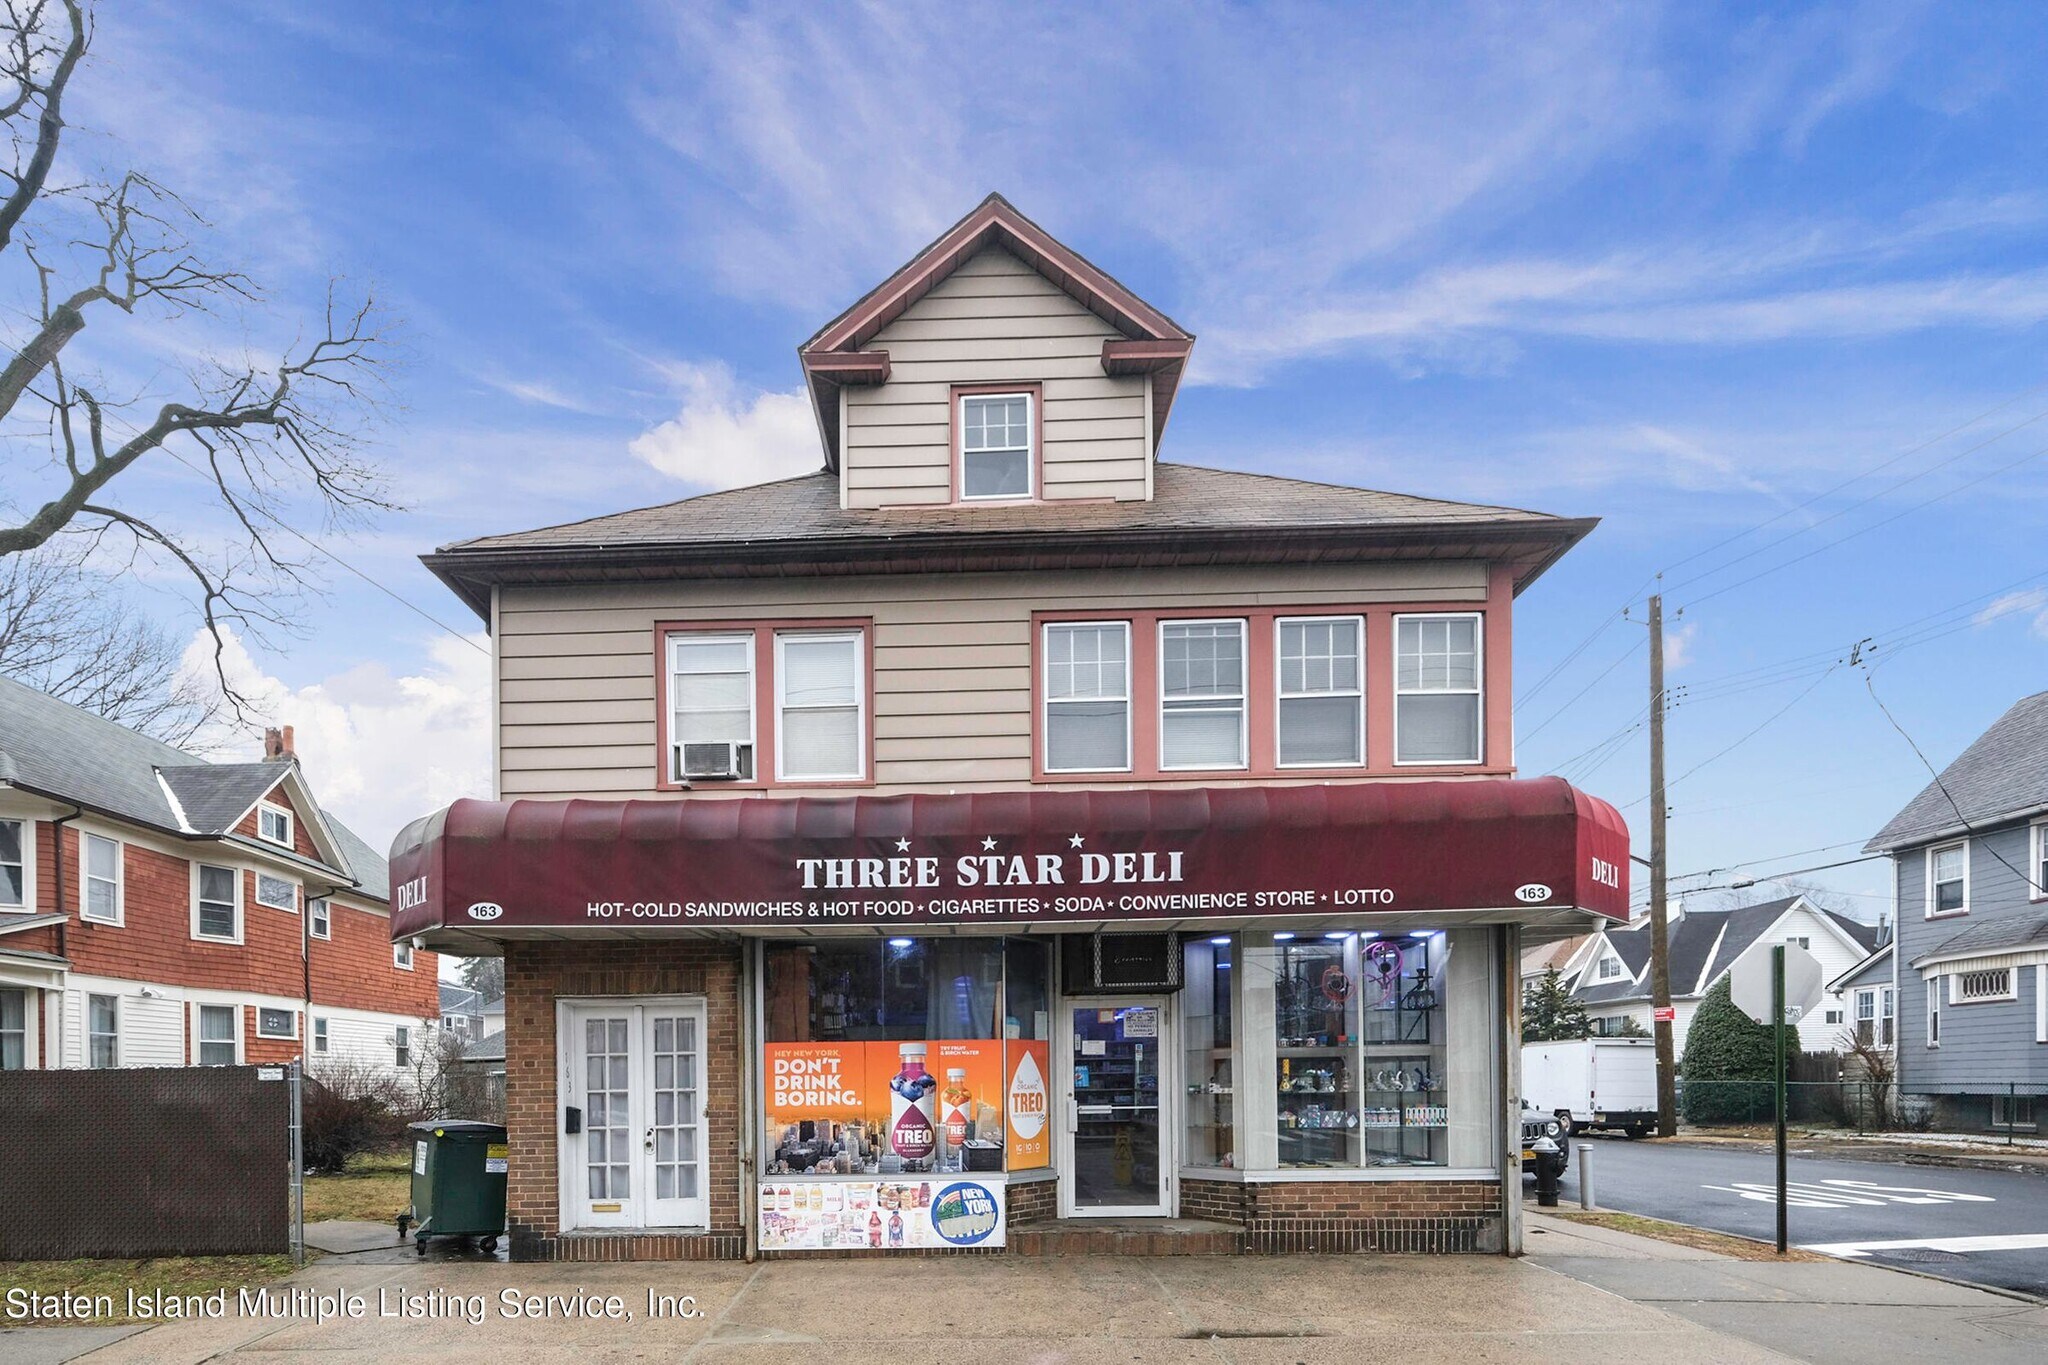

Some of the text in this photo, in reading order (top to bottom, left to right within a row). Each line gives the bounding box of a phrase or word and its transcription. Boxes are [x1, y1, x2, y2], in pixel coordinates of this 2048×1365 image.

[796, 851, 1184, 889] THREE STAR DELI
[1591, 856, 1619, 889] DELI
[397, 875, 428, 912] DELI
[1521, 887, 1546, 900] 163
[473, 905, 497, 917] 163
[586, 888, 1395, 918] HOT-COLD SANDWICHES & HOT FOOD CIGARETTES SODA CONVENIENCE STORE LOTTO
[774, 1058, 841, 1074] DON'T
[774, 1074, 842, 1090] DRINK
[774, 1090, 862, 1107] BORING.
[1012, 1092, 1043, 1113] TREO
[895, 1129, 933, 1144] TREO
[961, 1188, 985, 1200] NEW
[964, 1199, 994, 1215] YORK
